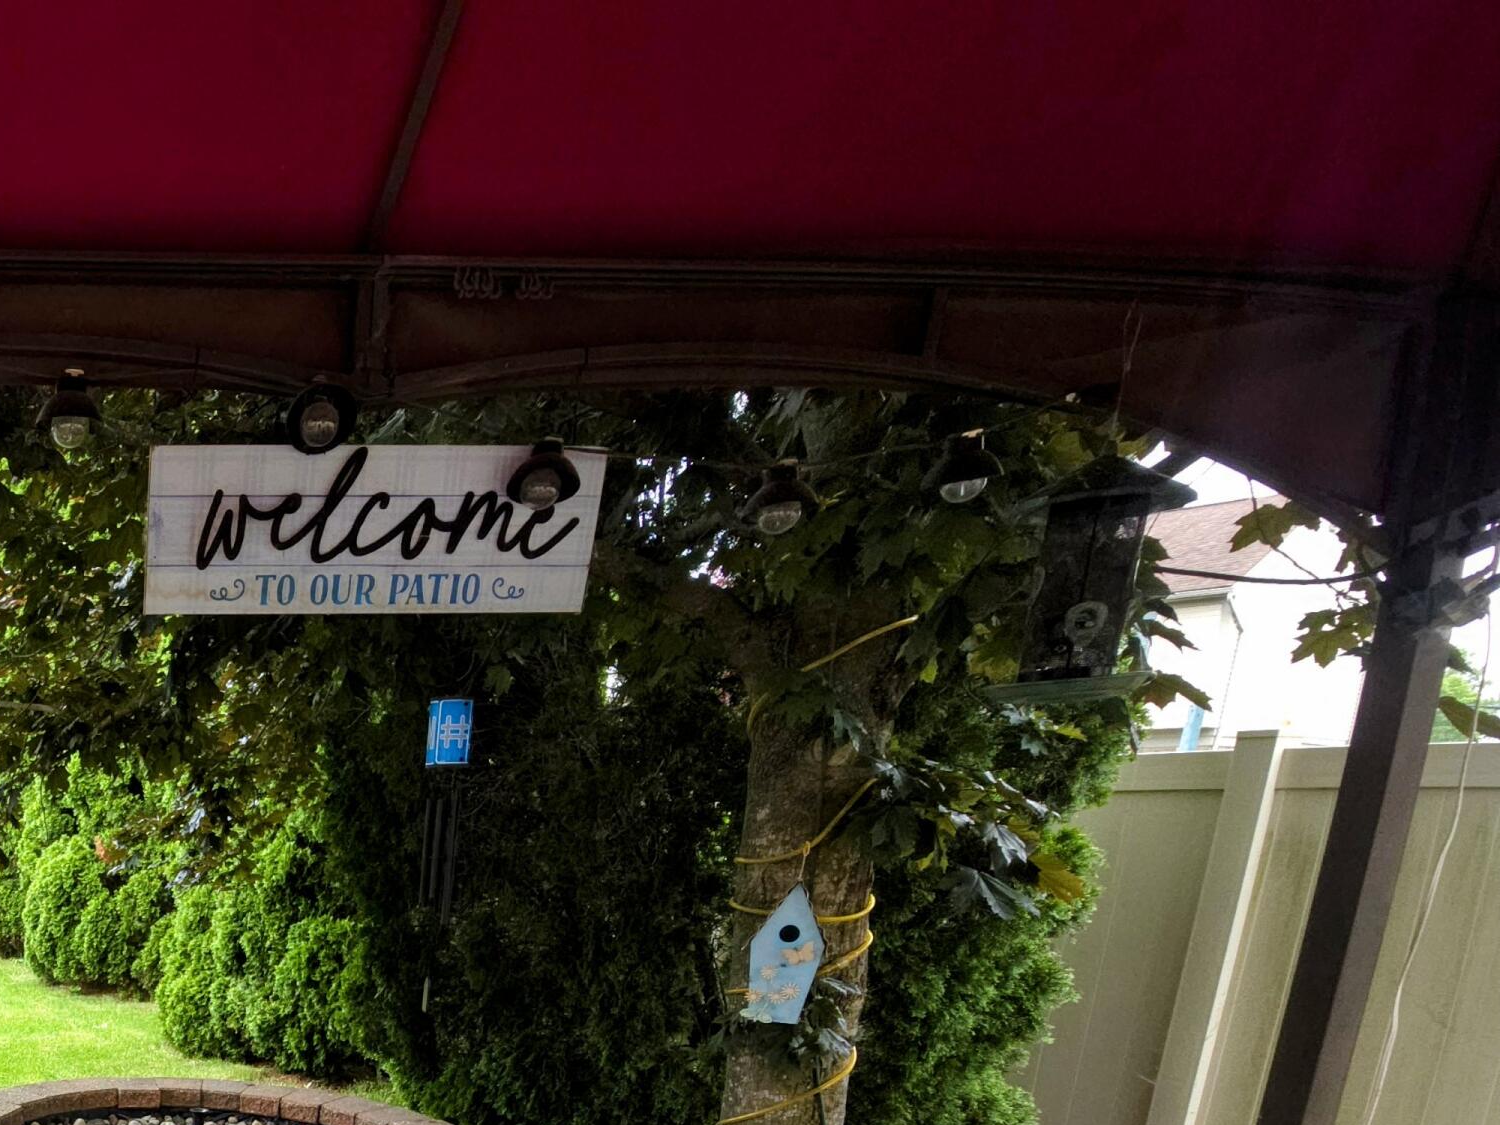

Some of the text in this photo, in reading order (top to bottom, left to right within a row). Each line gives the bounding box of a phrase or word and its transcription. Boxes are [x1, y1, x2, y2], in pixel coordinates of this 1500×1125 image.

[195, 446, 580, 571] welcome
[255, 573, 481, 606] TO OUR PATIO
